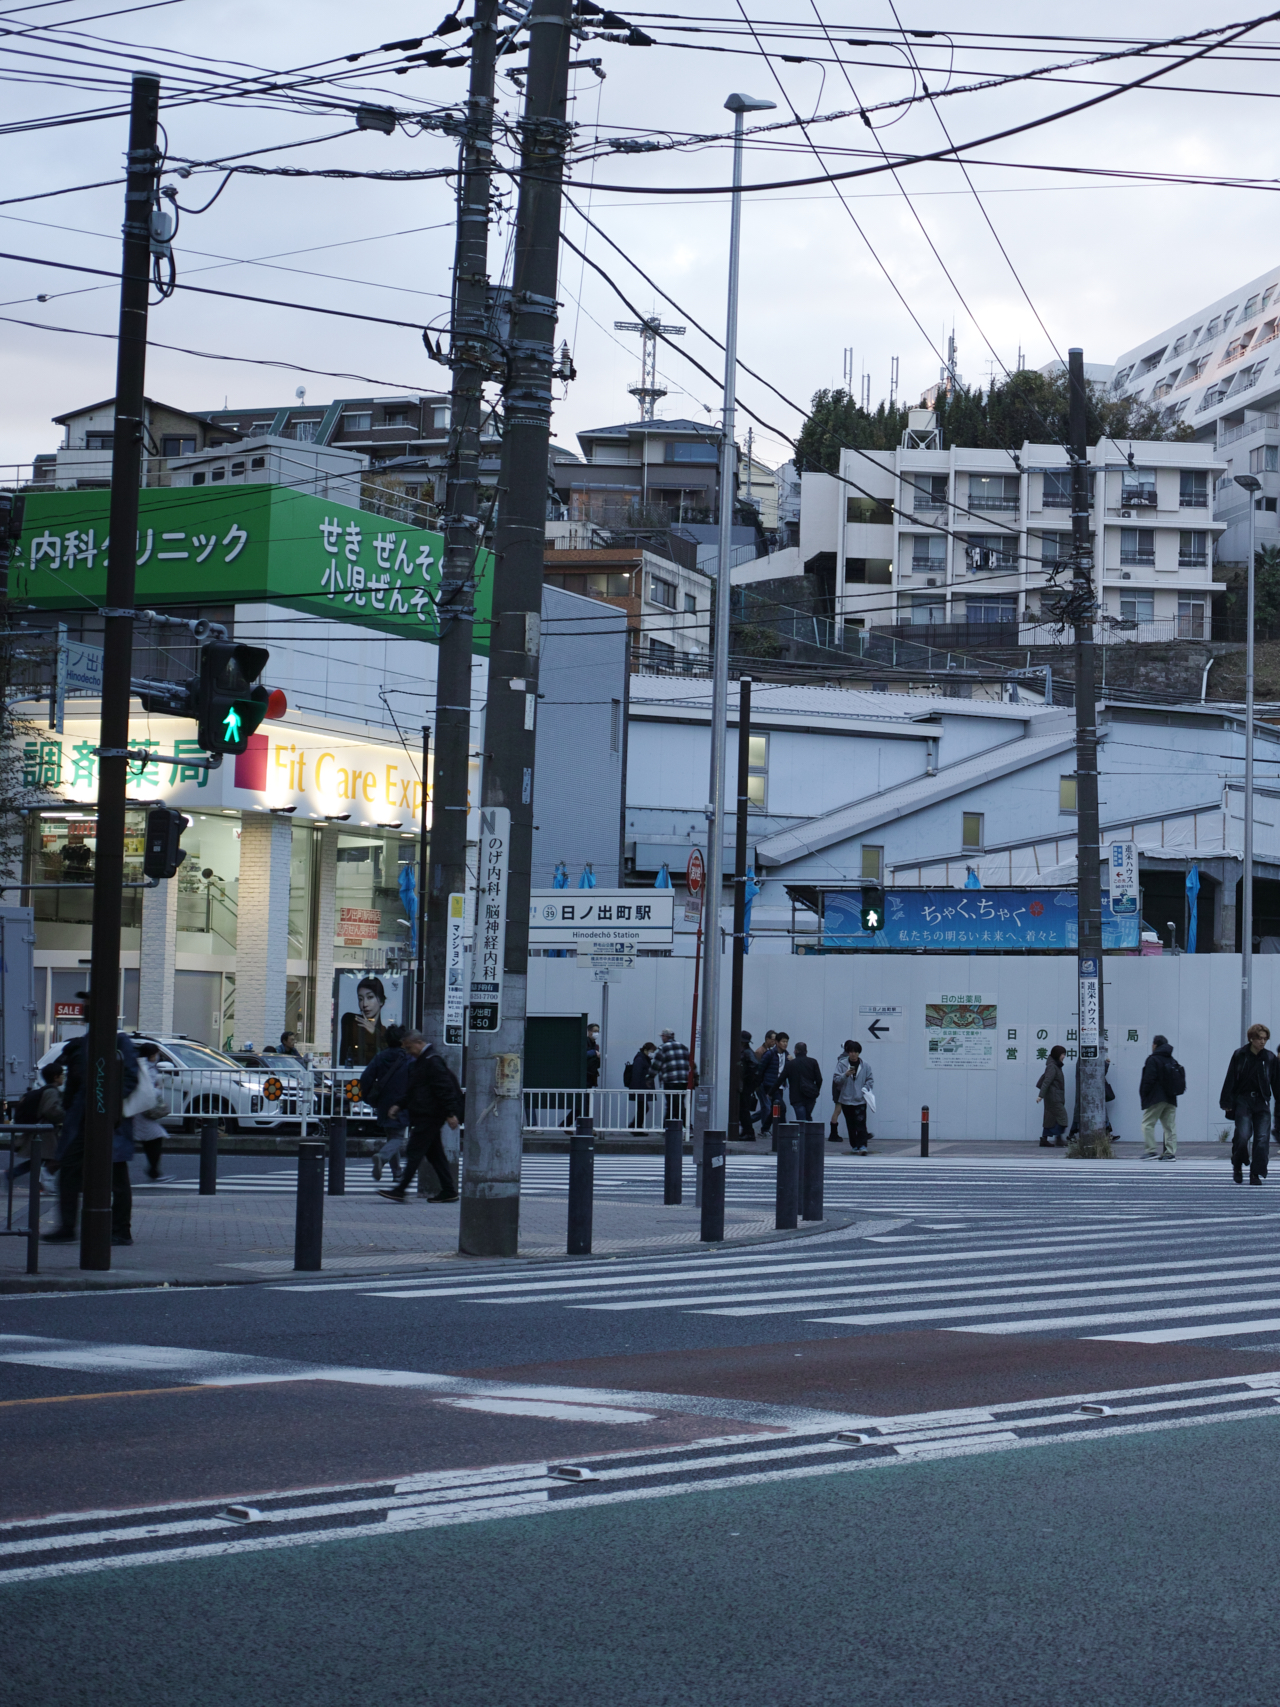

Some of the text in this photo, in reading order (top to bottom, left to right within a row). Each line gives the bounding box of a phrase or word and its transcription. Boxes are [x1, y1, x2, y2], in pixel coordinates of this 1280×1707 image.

[319, 516, 362, 561] せき
[65, 647, 104, 673] ノ出
[67, 669, 101, 686] Hinodecho
[275, 743, 306, 793] Fit
[315, 752, 377, 804] Care
[1125, 844, 1134, 884] 進栄ハウス
[483, 837, 504, 982] のげ内科・脳神経内科
[561, 905, 652, 921] 日ノ出町駅
[452, 924, 461, 967] マンション
[613, 931, 640, 939] Station
[899, 929, 1058, 942] 私たちの明るい未来へ、着々と
[57, 1005, 80, 1015] SALE
[941, 994, 982, 1004] 日の出薬局
[1087, 981, 1097, 1026] 進栄ハウス
